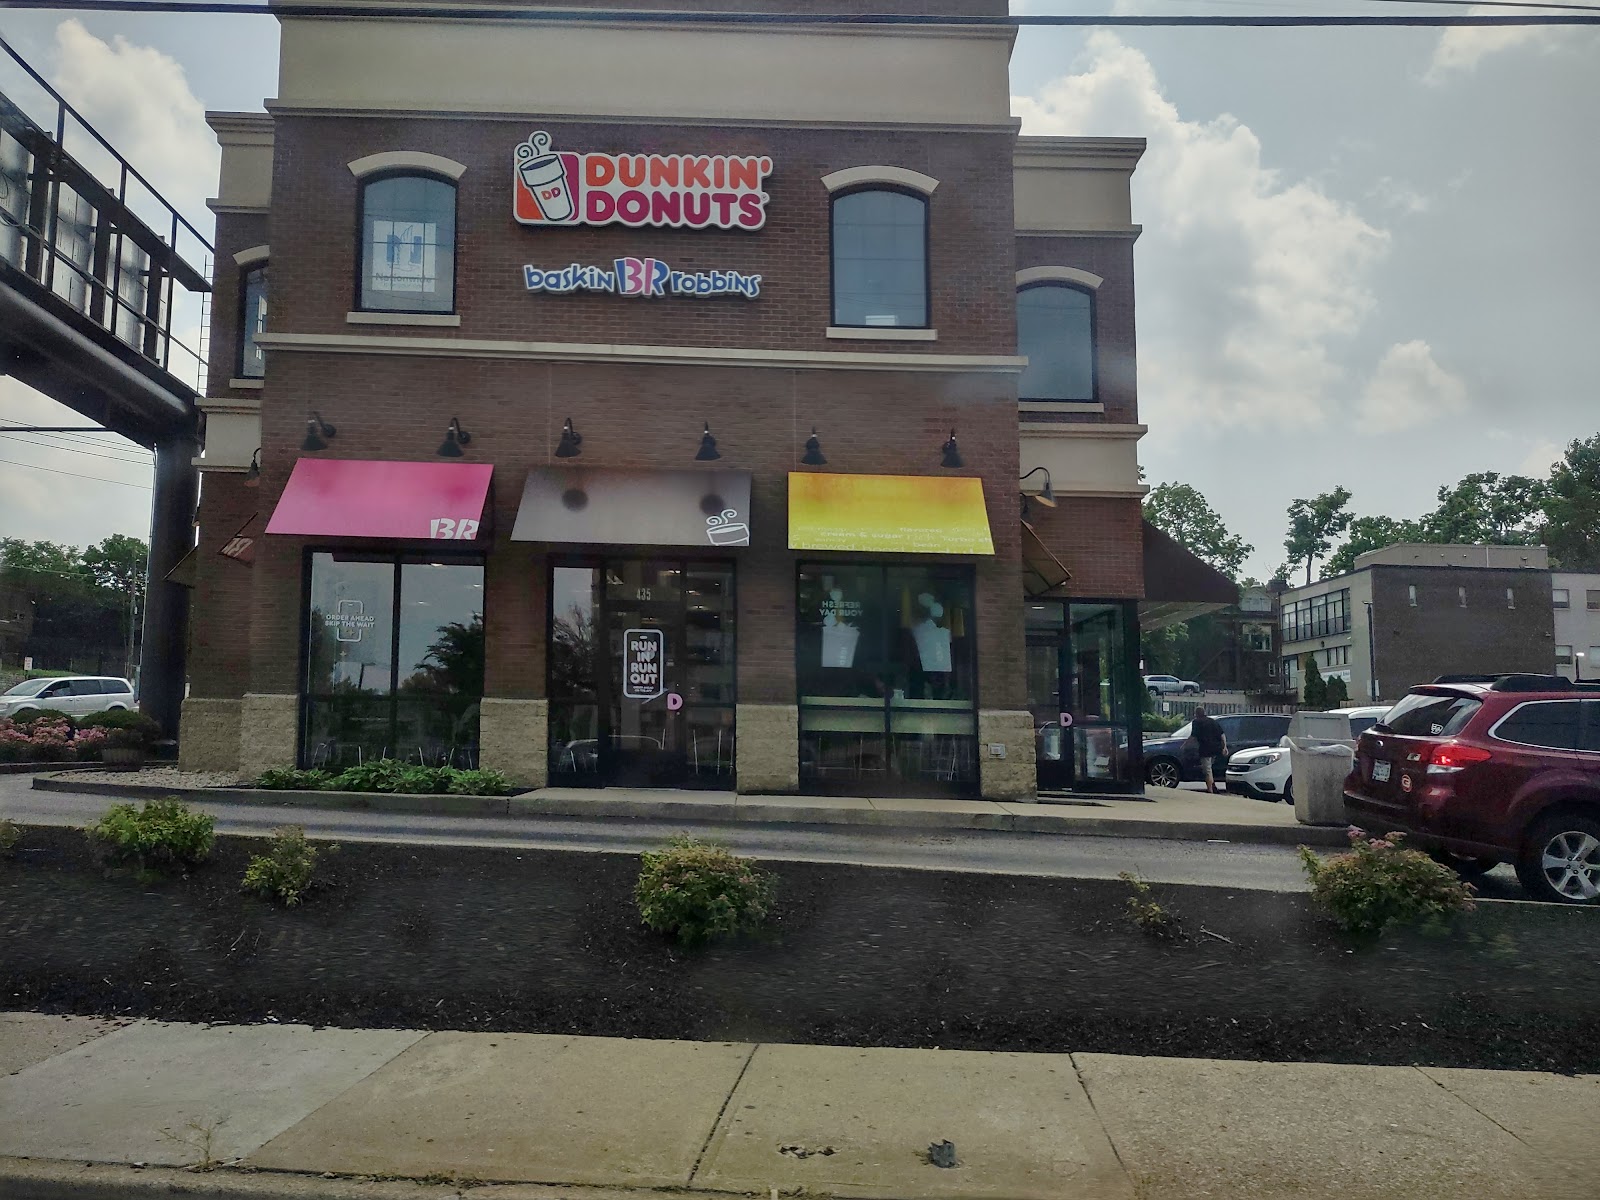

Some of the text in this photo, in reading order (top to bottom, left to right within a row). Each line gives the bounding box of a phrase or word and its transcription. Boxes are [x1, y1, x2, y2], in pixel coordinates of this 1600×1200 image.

[585, 155, 770, 190] DUNKIN'
[541, 187, 561, 200] DD
[586, 190, 762, 226] DONUTS
[525, 257, 761, 297] baskin BR robbins
[430, 518, 480, 540] BR
[636, 588, 651, 601] 435
[630, 640, 658, 652] RUN
[630, 662, 658, 674] RUN
[629, 673, 658, 685] OUT
[666, 693, 683, 710] D
[1060, 712, 1073, 727] D
